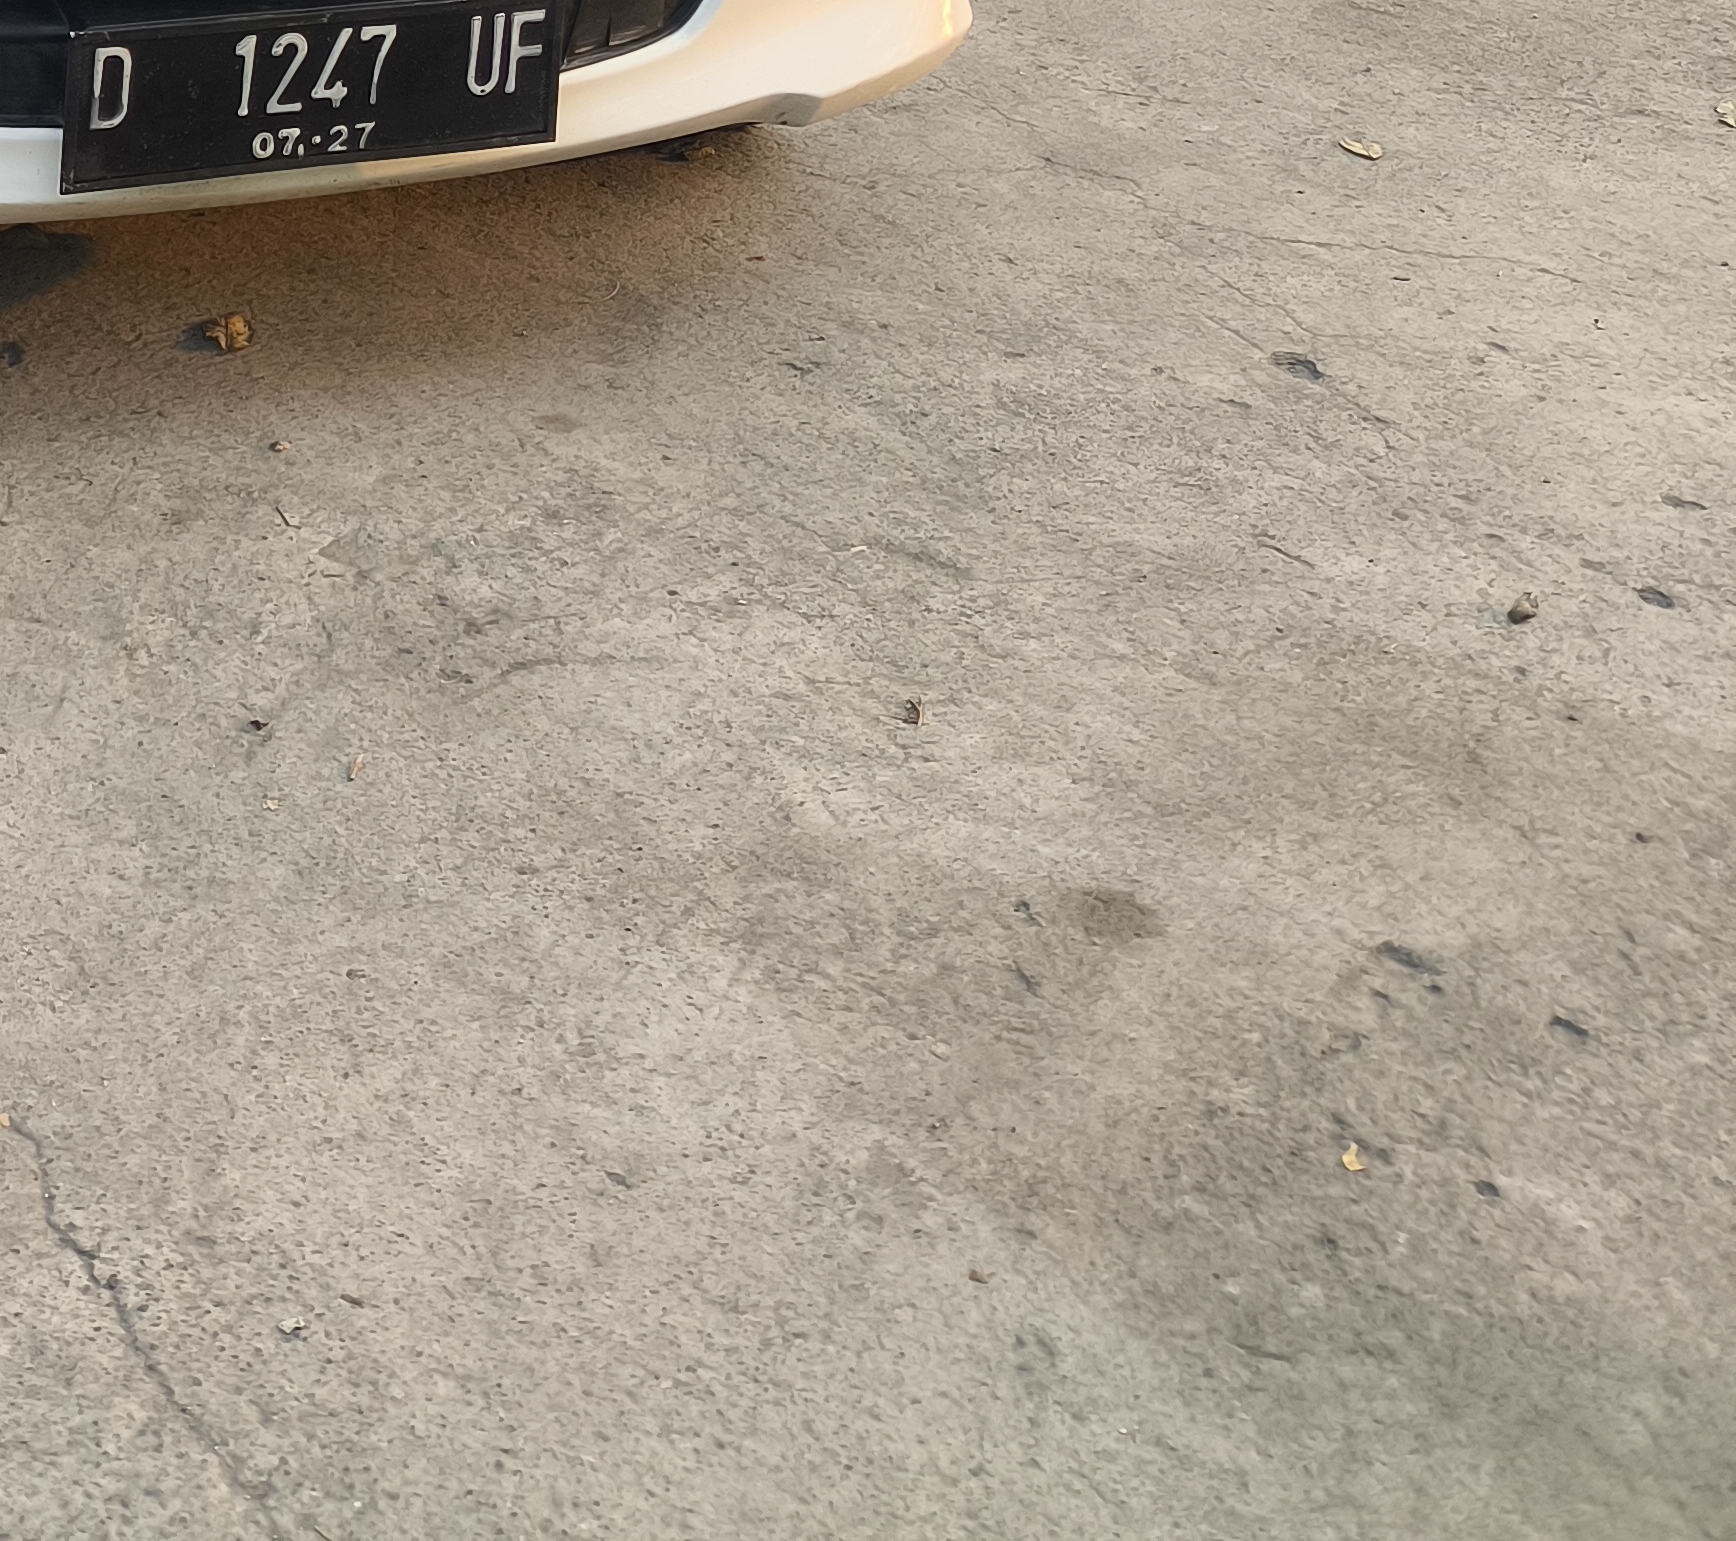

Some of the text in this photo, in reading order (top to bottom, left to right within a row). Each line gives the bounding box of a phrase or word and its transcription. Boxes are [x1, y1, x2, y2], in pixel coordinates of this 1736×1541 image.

[89, 9, 545, 131] D 1247 UF
